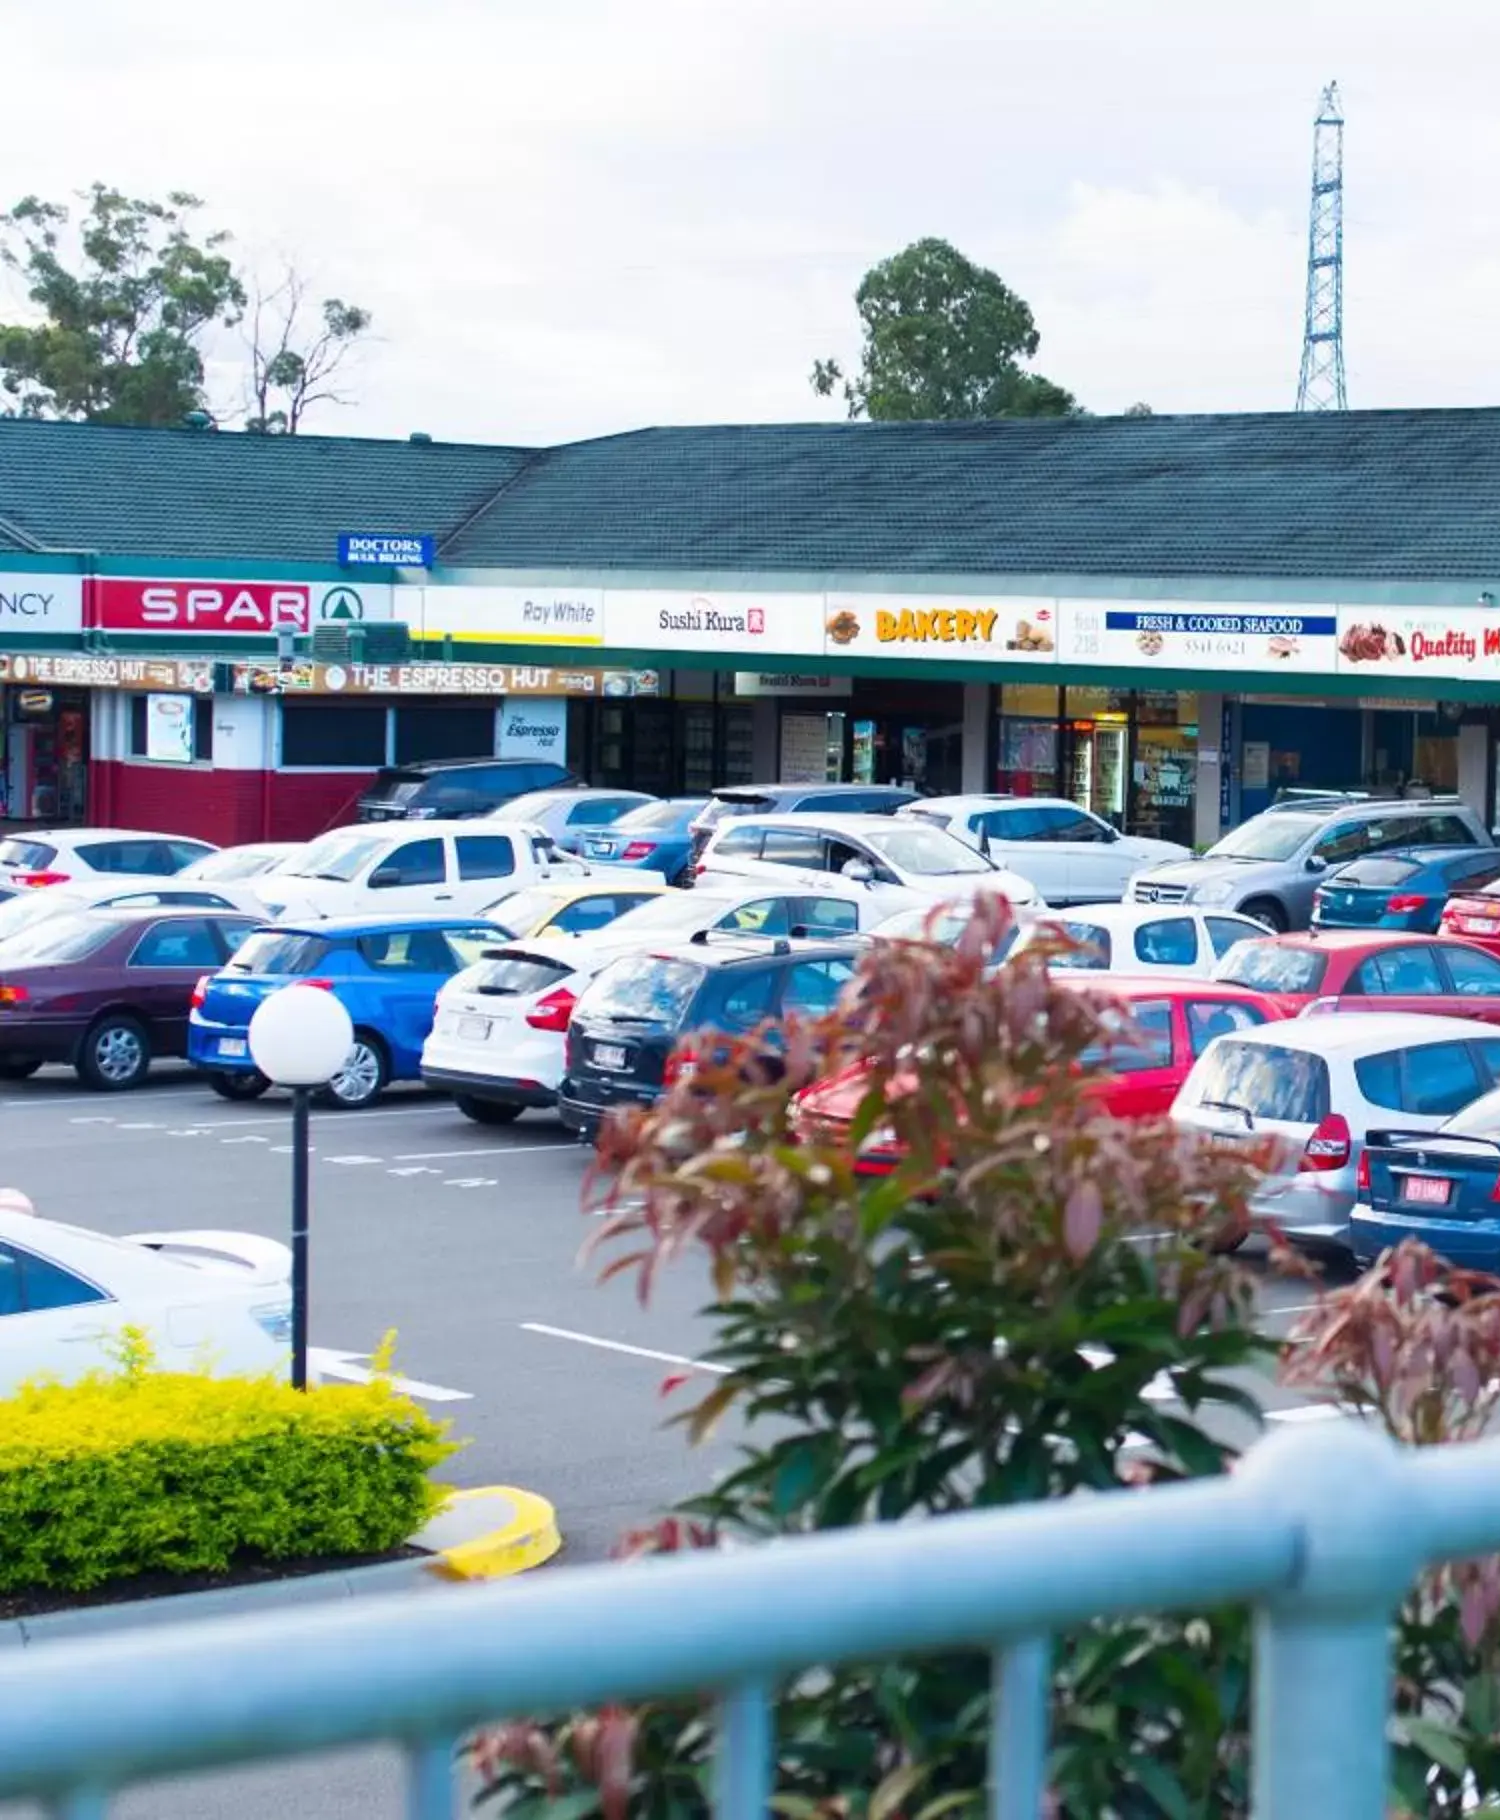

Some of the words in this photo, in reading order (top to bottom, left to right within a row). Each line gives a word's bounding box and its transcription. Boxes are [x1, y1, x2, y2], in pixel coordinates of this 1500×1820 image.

[349, 537, 422, 552] DOCTORS
[0, 592, 54, 614] NCY
[141, 587, 305, 624] SPAR
[523, 601, 550, 624] Ray
[553, 600, 595, 622] White
[659, 608, 701, 630] Sushi
[705, 610, 745, 632] Kura
[875, 607, 998, 643] BAKERY
[1135, 614, 1173, 630] FRESH
[1175, 616, 1185, 630] &
[1187, 616, 1241, 632] COOKED
[1243, 617, 1303, 633] SEAFOOD
[1410, 631, 1477, 662] Quality
[28, 656, 51, 677] THE
[54, 657, 119, 680] ESPRESSO
[119, 661, 147, 681] HUT
[351, 667, 390, 687] THE
[399, 667, 505, 689] ESPRESSO
[510, 668, 551, 689] HUT
[506, 723, 560, 738] Espresso
